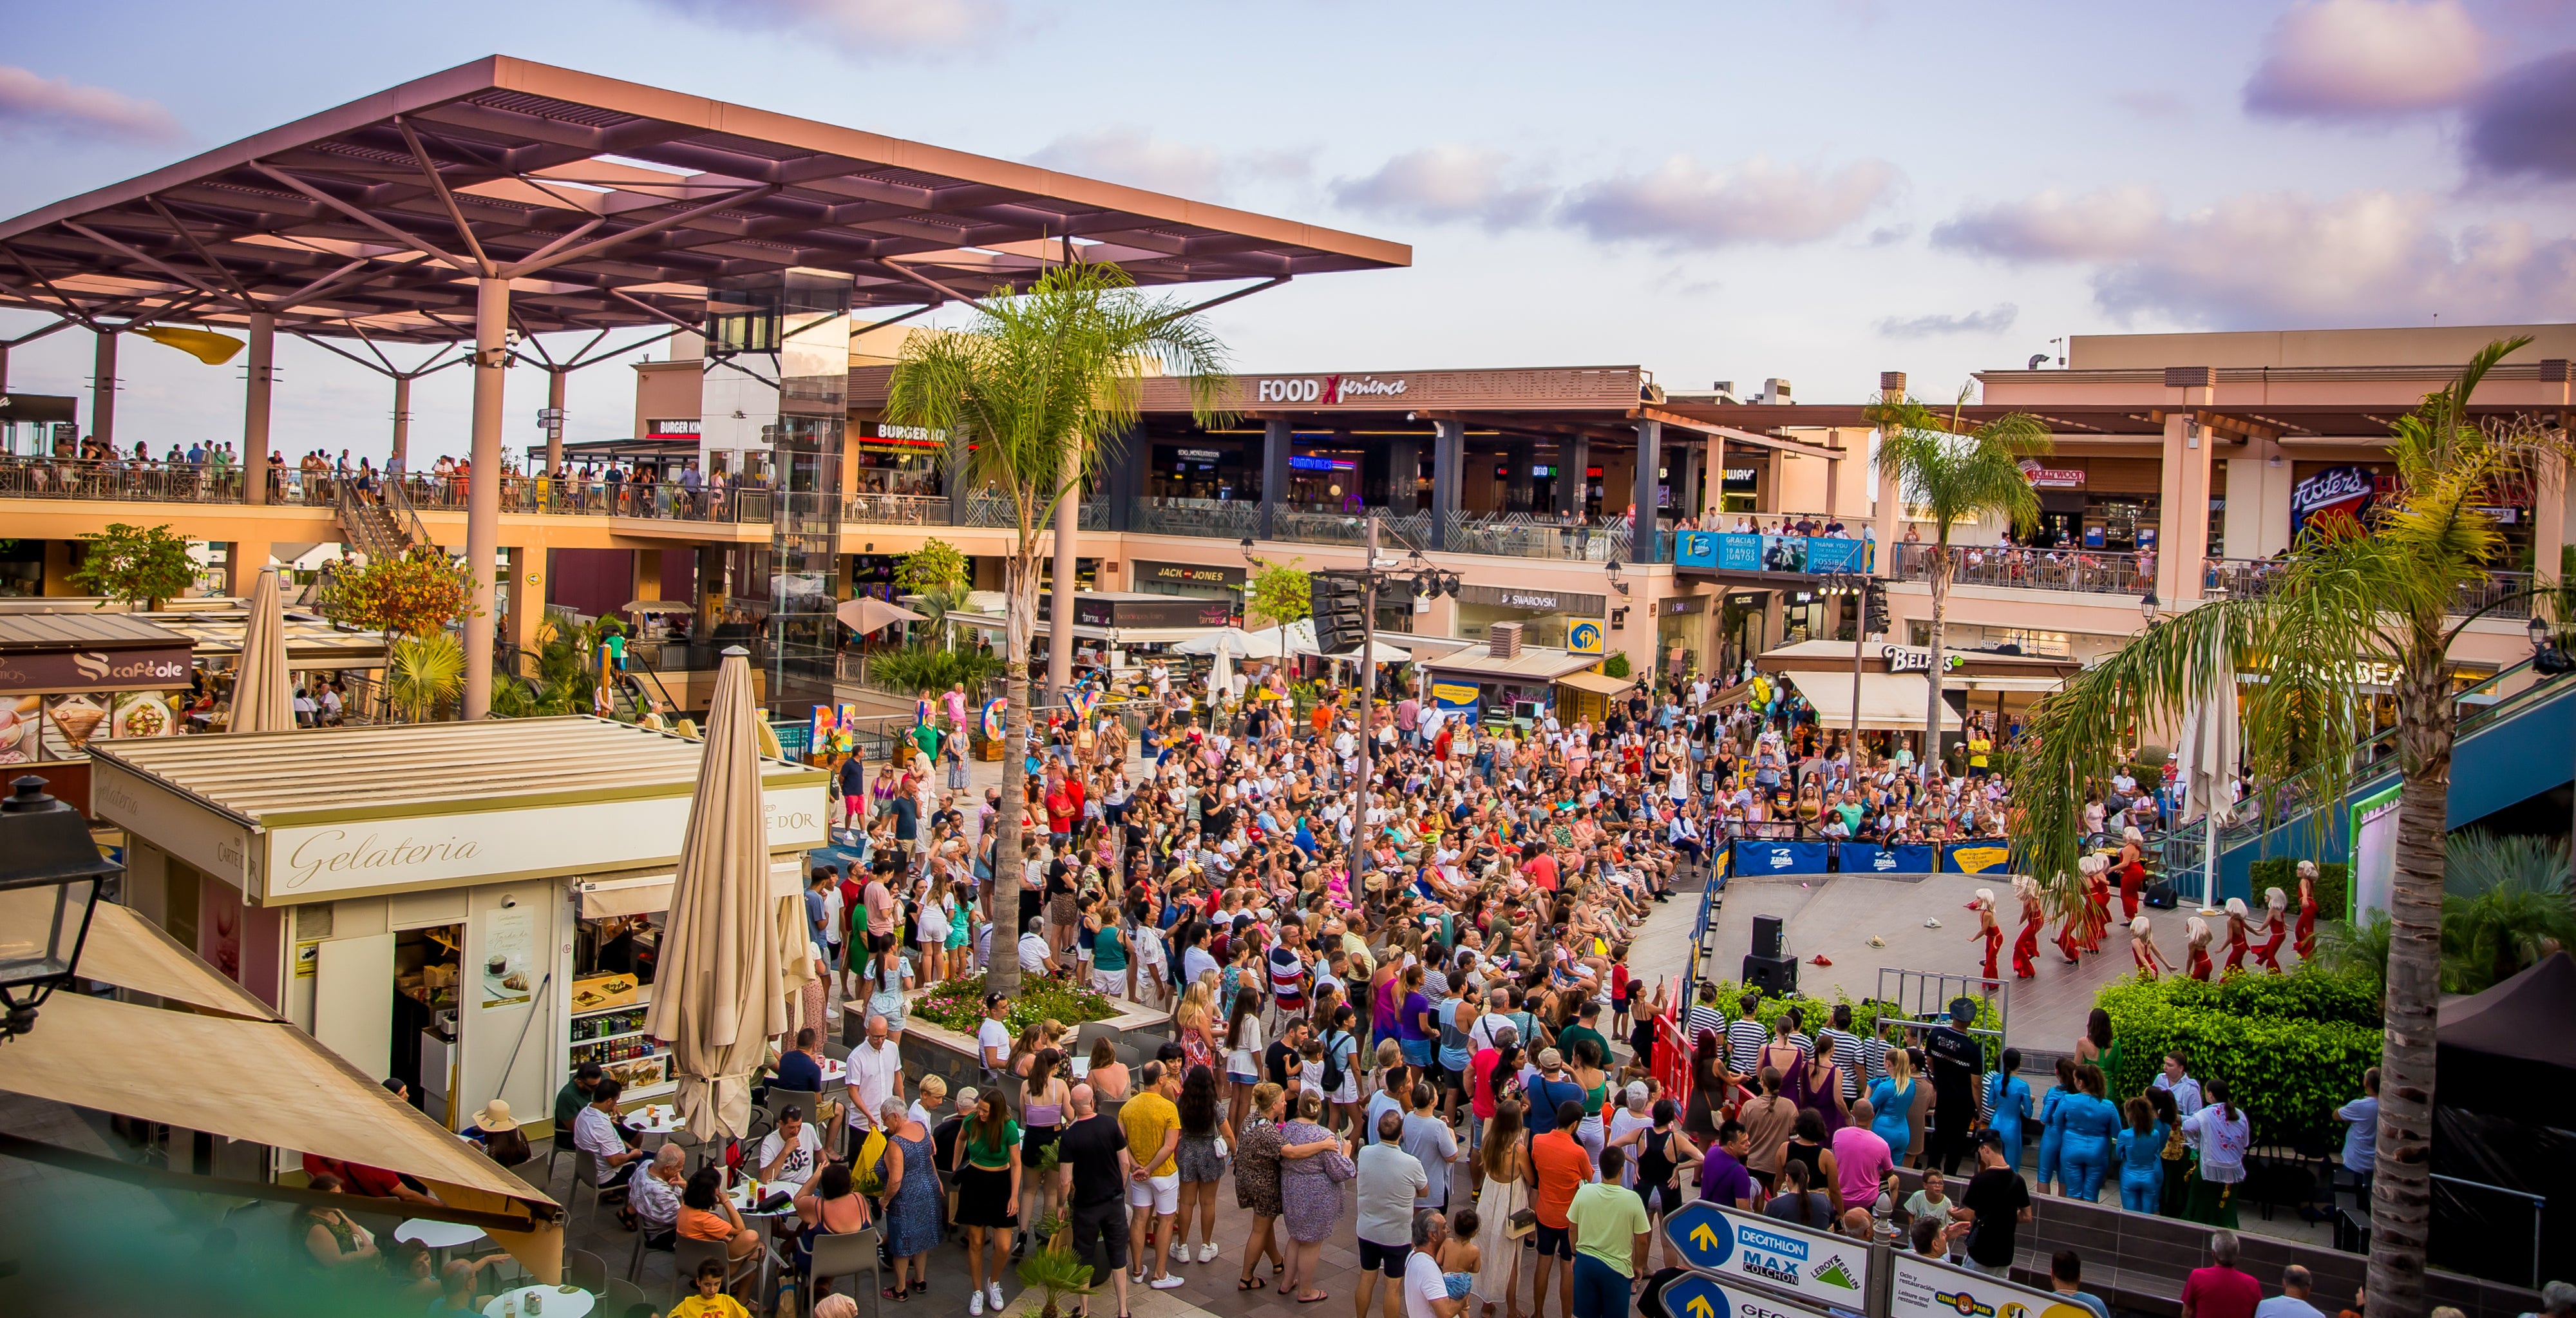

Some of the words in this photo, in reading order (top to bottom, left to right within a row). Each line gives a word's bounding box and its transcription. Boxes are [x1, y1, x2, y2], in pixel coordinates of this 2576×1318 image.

[1259, 379, 1320, 402] FOOD
[1322, 373, 1408, 404] Xperience
[660, 421, 687, 434] BURGER
[878, 424, 928, 441] BURGER
[1293, 457, 1314, 468] TOMMY
[2031, 470, 2085, 481] HOLLYWOOD
[2292, 466, 2371, 513] Foster's
[1159, 568, 1182, 578] JACK
[1193, 569, 1224, 581] JONES
[1512, 595, 1557, 607] SWAROVSKI
[1082, 611, 1110, 625] terrassa
[1198, 615, 1227, 626] terrassa
[1881, 645, 1953, 672] BELRS
[217, 841, 239, 868] CARTE
[286, 829, 483, 889] Gelateria
[1741, 1230, 1804, 1256] DECATHLON
[1743, 1250, 1799, 1276] MAX
[1743, 1263, 1799, 1285] COLCHON
[1810, 1257, 1835, 1279] LEROY
[1832, 1254, 1861, 1290] MERLIN
[1899, 1271, 1913, 1280] Ocio
[1899, 1277, 1935, 1292] restauración
[1897, 1295, 1928, 1308] restoration
[1898, 1289, 1918, 1299] Leisure
[1741, 1303, 1791, 1318] GE
[1937, 1293, 1956, 1305] ZENIA
[1972, 1303, 1991, 1315] PARK
